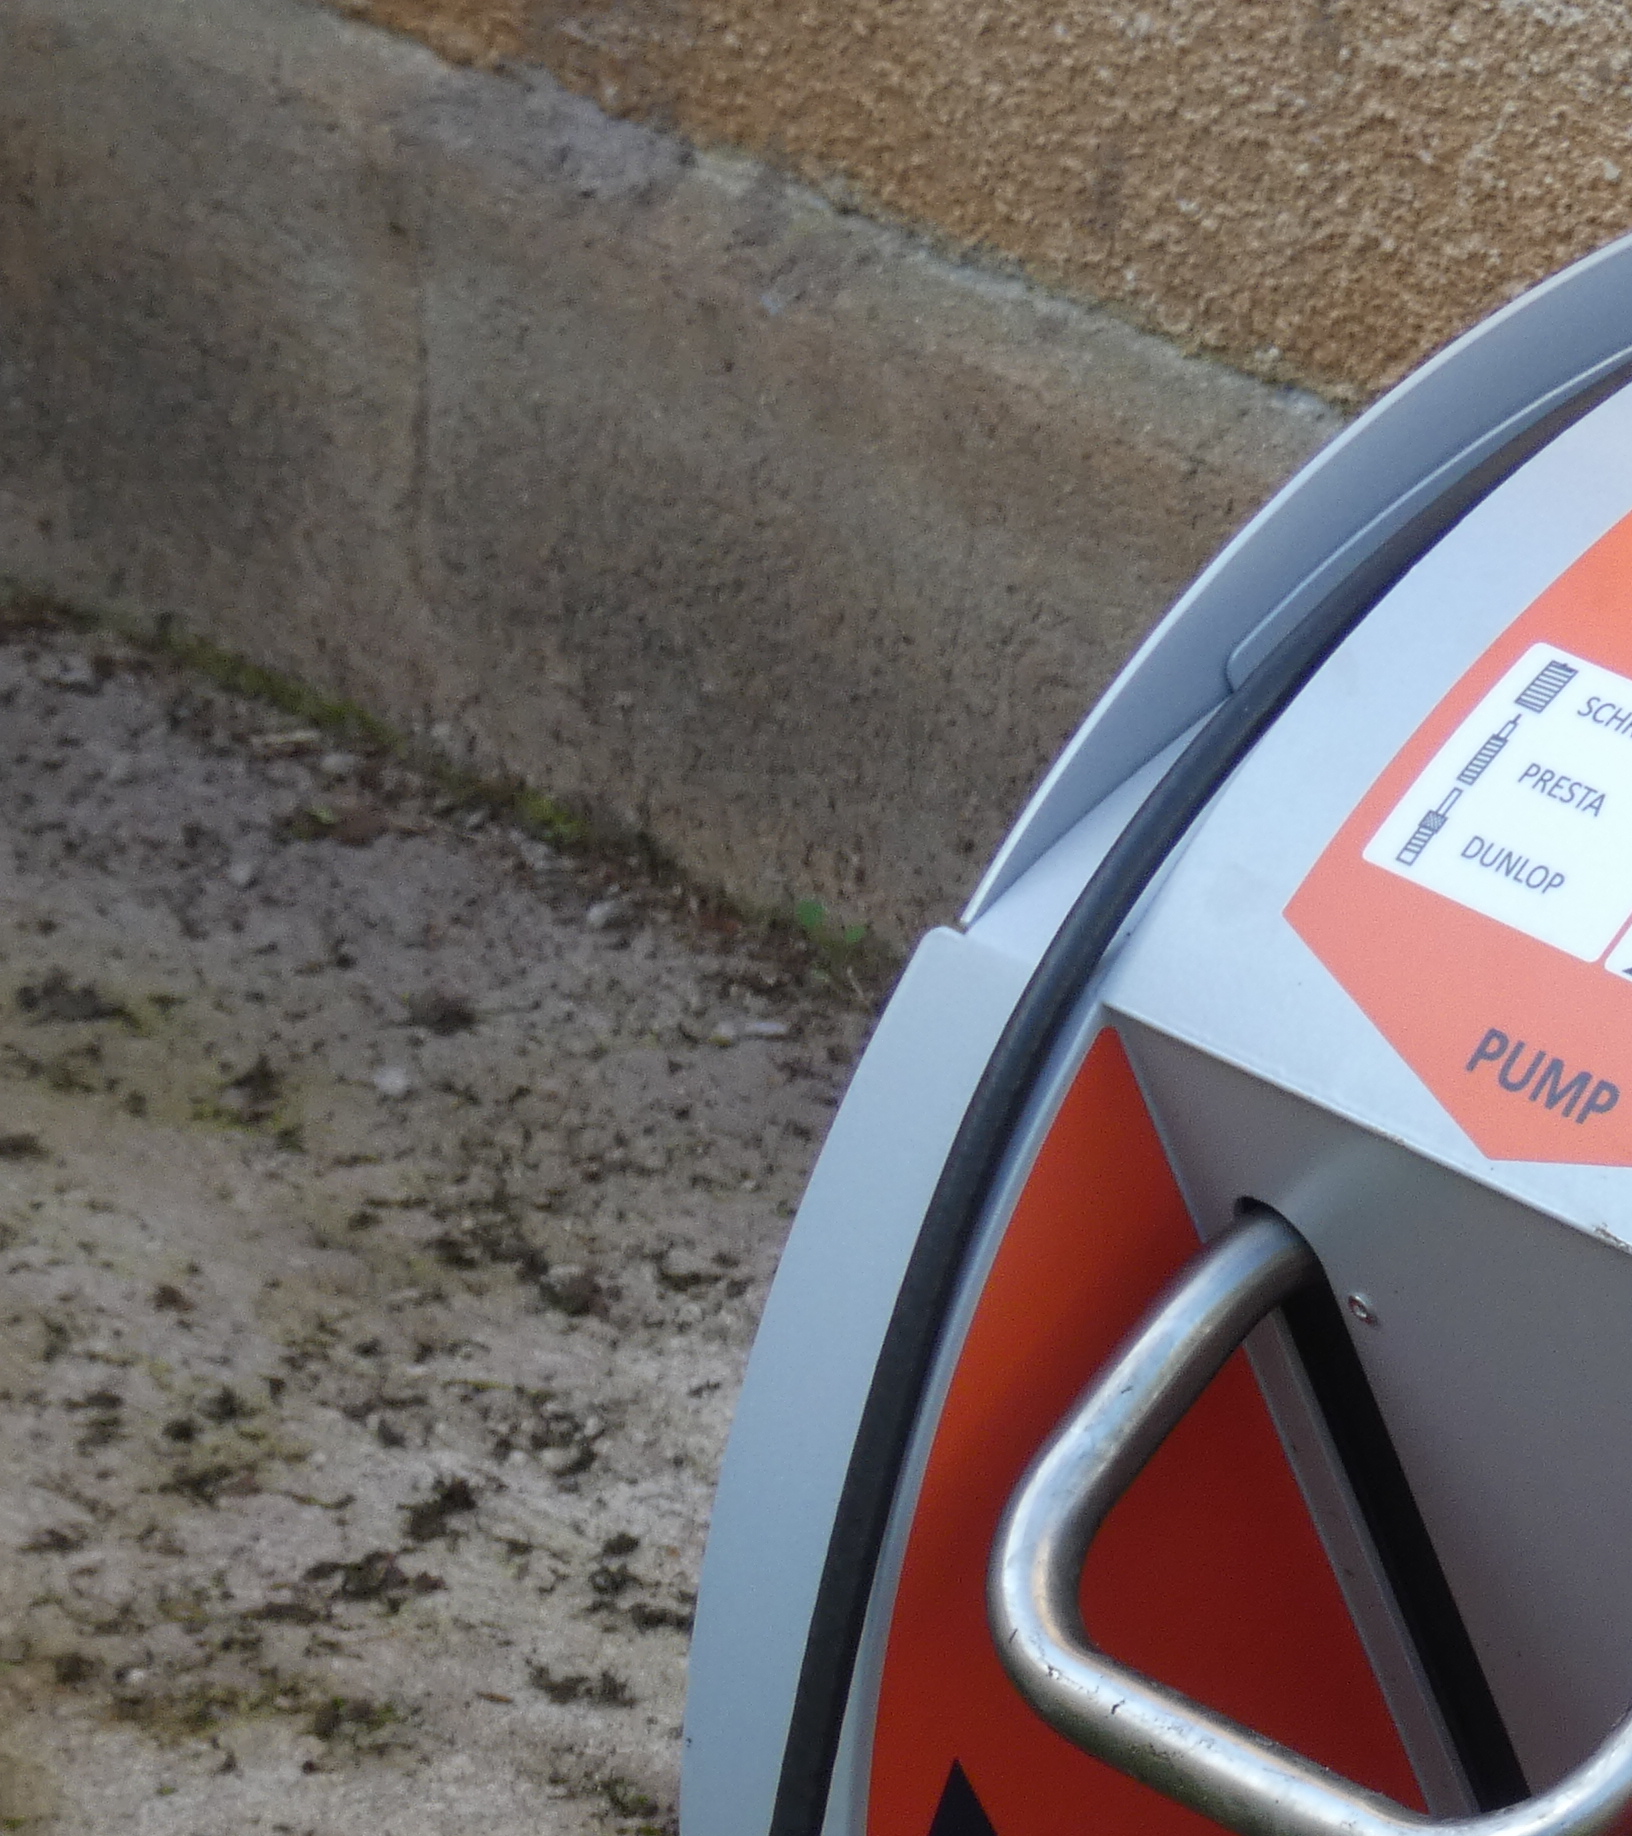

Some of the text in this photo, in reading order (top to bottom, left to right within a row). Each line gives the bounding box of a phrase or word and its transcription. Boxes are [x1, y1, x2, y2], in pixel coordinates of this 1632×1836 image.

[1517, 763, 1606, 817] PRESTA
[1460, 835, 1565, 894] DUNLOP
[1466, 1028, 1620, 1124] PUMP
